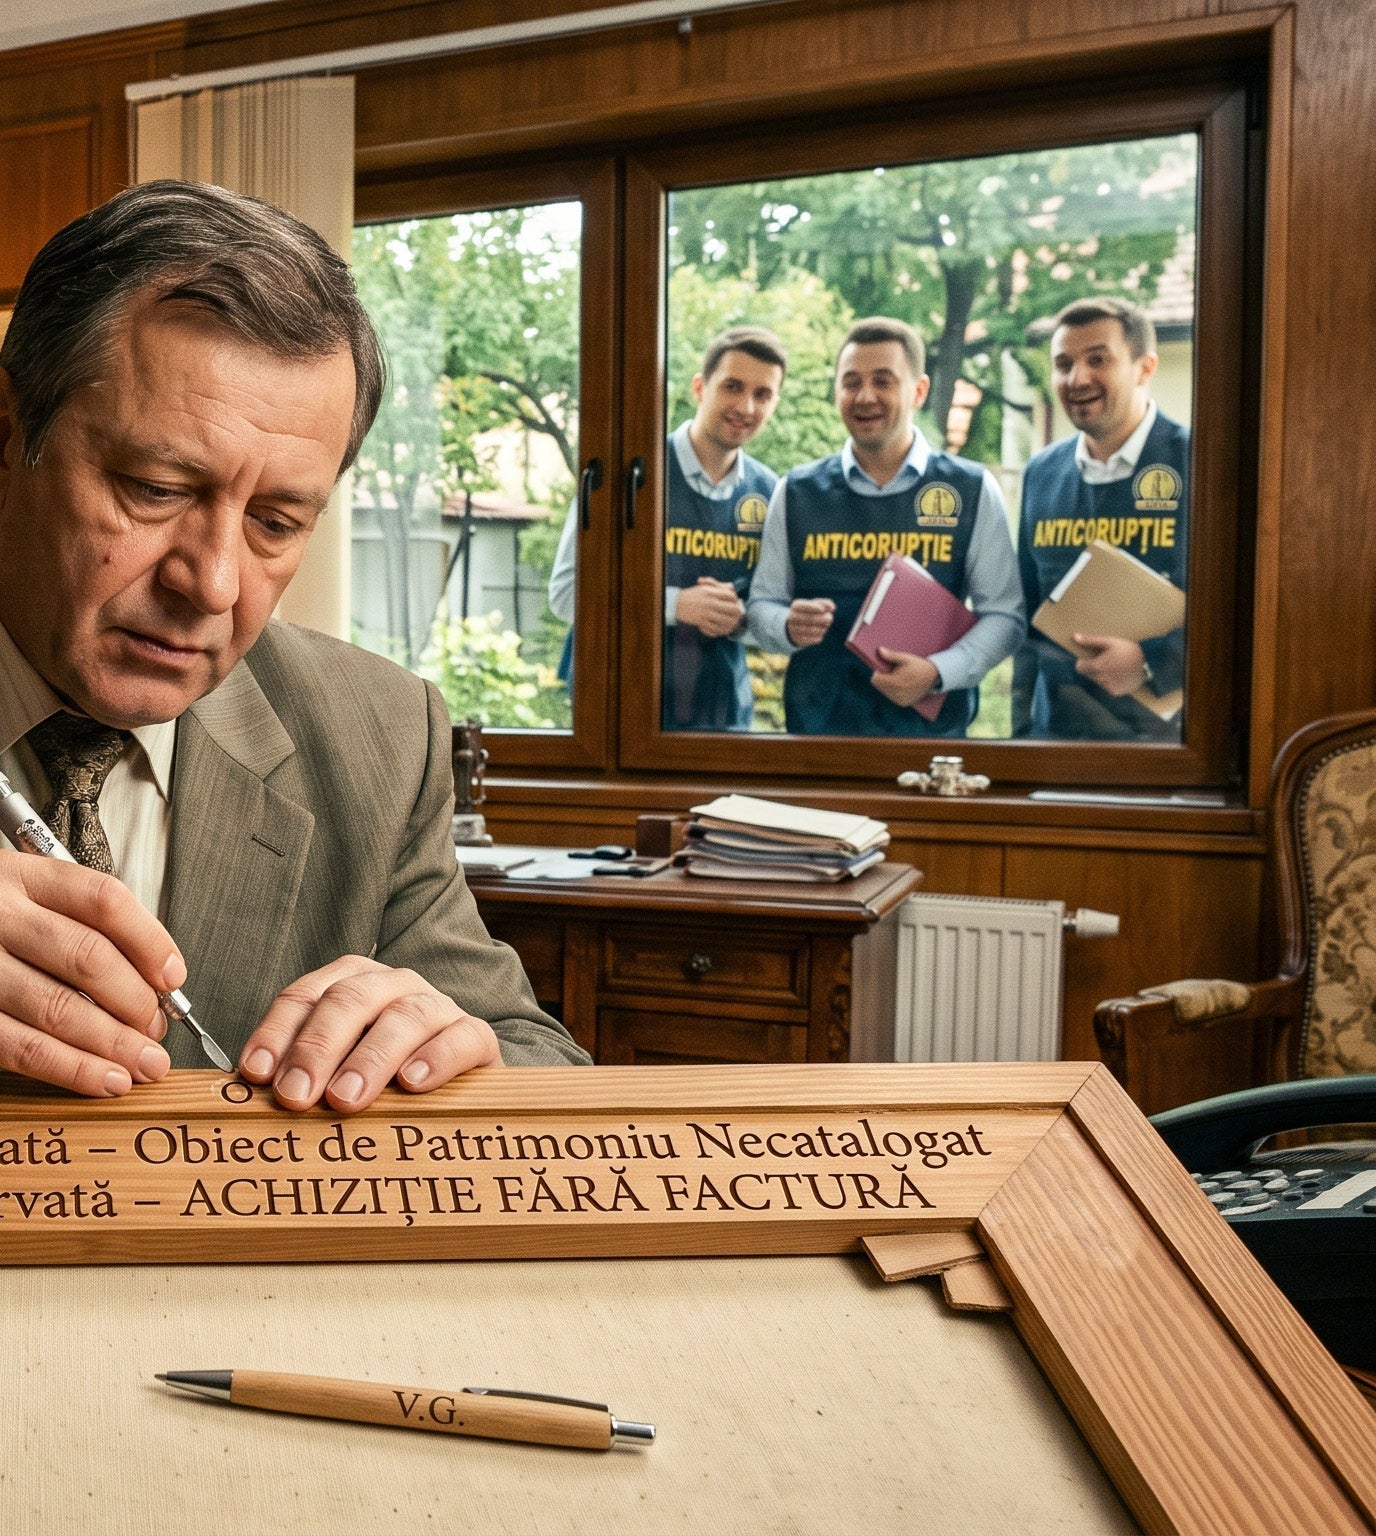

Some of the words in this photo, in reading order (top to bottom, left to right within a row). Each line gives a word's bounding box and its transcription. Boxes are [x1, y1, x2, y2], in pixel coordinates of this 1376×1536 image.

[134, 1124, 305, 1164] Obiect
[317, 1123, 378, 1162] de
[390, 1124, 680, 1162] Patrimoniu
[686, 1118, 992, 1170] Necatalogat
[180, 1176, 482, 1227] ACHIZIȚIE
[492, 1165, 651, 1213] FĂRĂ
[656, 1163, 937, 1212] FACTURĂ
[392, 1390, 466, 1427] V.G.
